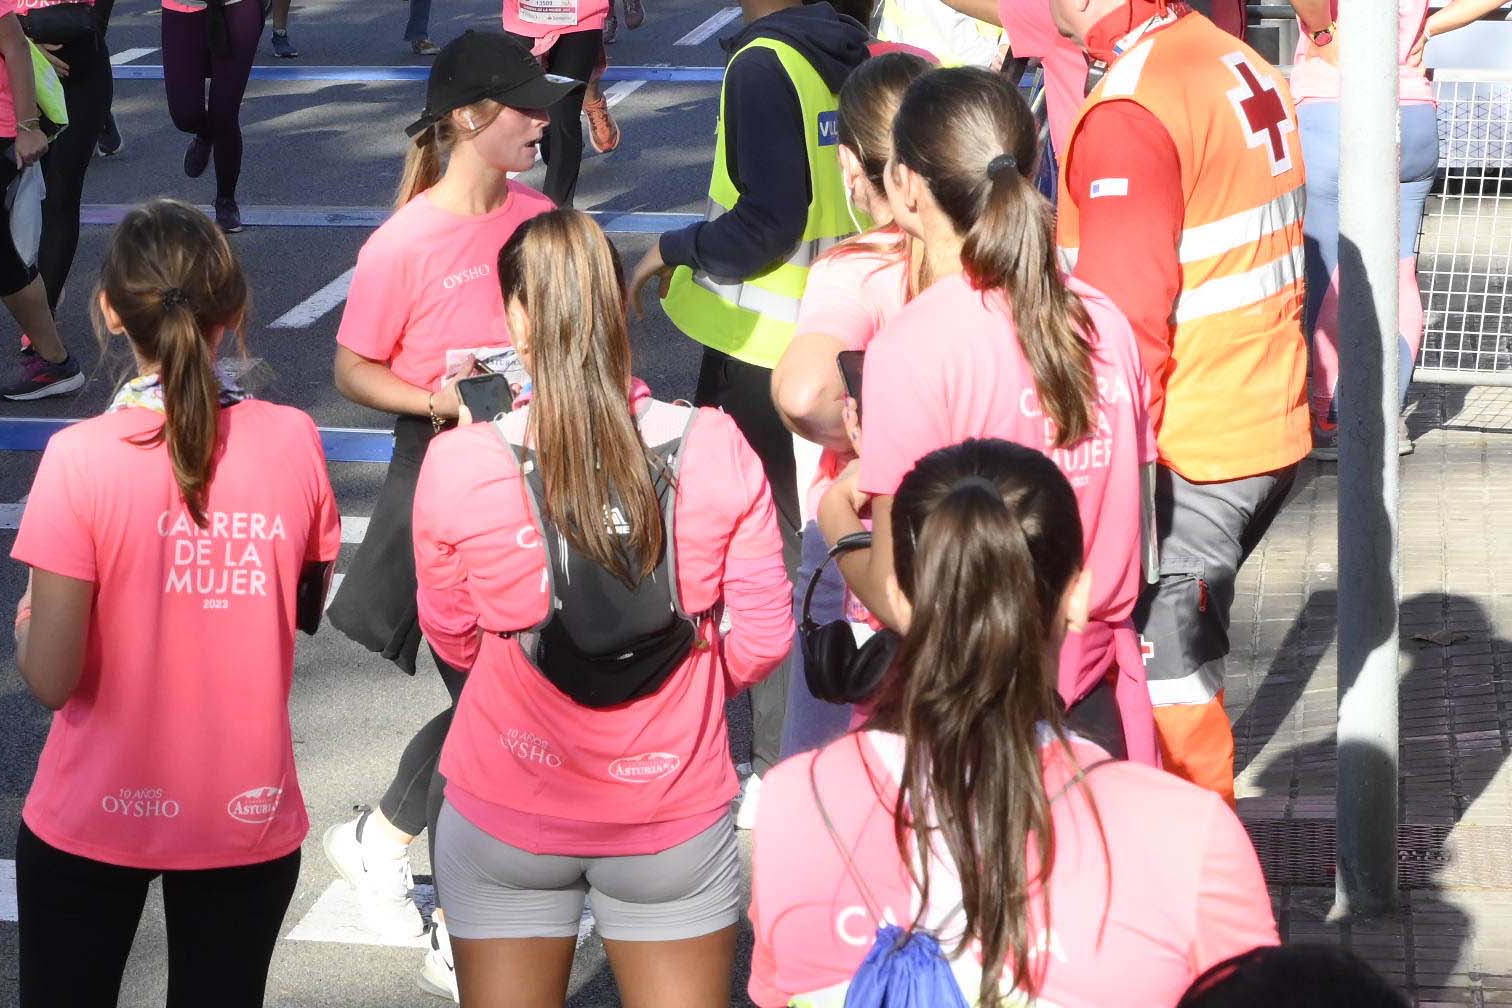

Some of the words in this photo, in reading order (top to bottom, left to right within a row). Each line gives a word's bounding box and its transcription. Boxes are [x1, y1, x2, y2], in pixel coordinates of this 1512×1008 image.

[443, 263, 490, 289] OYSHO
[157, 510, 287, 540] CARRERA
[174, 539, 213, 566] DE
[224, 540, 263, 569] LA
[165, 569, 267, 597] MUJER
[203, 598, 229, 609] 2023
[120, 789, 133, 799] 10
[134, 786, 163, 799] AÑOS
[102, 795, 181, 819] OYSHO
